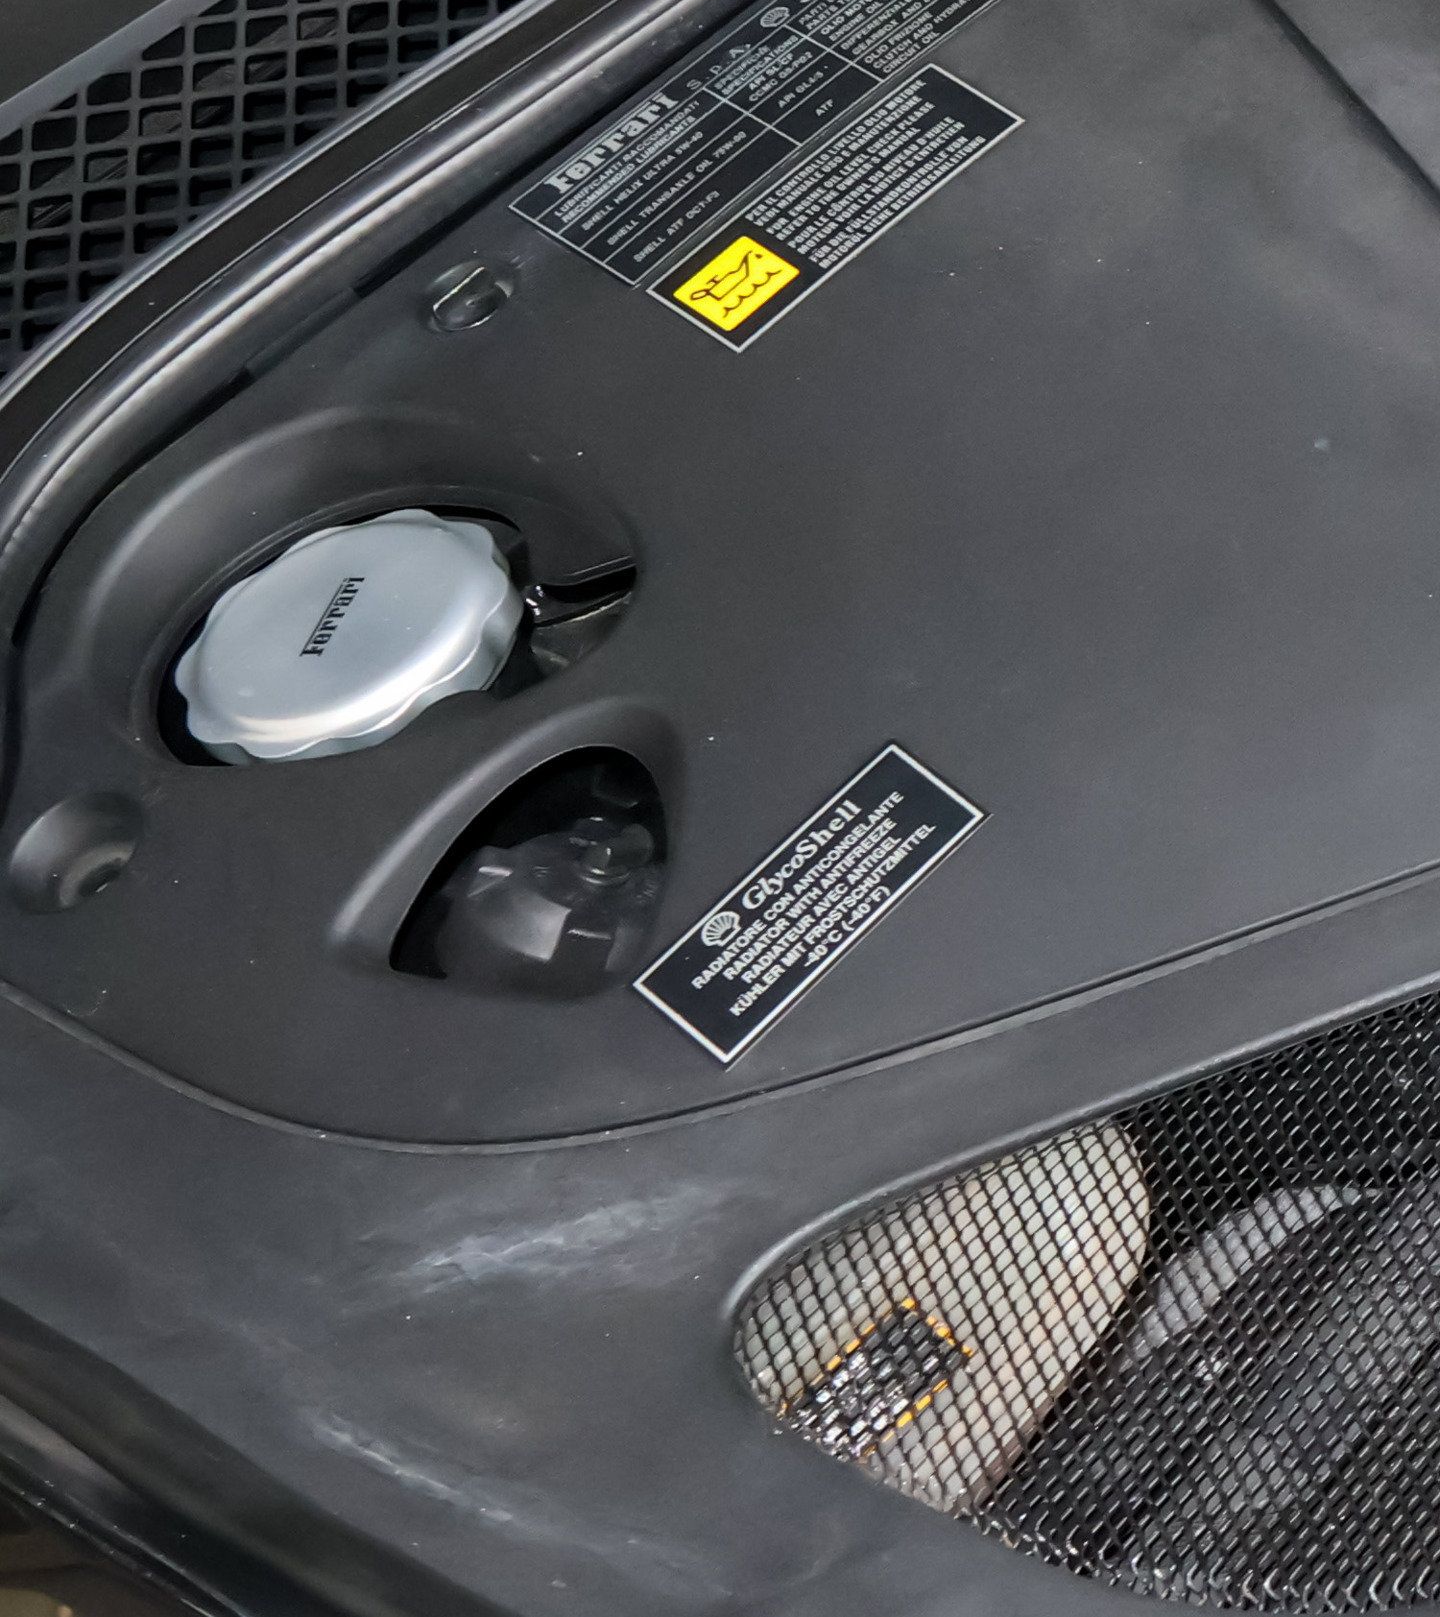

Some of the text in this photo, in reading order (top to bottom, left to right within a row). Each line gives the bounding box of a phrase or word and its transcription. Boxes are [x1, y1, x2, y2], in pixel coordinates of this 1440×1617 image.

[545, 93, 676, 192] Ferrari
[299, 577, 365, 657] Ferrari
[692, 791, 902, 988] RADIATORE CON ANTICONGELANTE
[723, 818, 895, 979] RADIATOR WITH ANTIFREEZE
[729, 825, 934, 1015] KÜHLER MIT FROSTSCHUTZMITTEL
[741, 836, 901, 982] RADIATEUR AVEC ANTIGEL
[742, 800, 860, 909] GlycoShell
